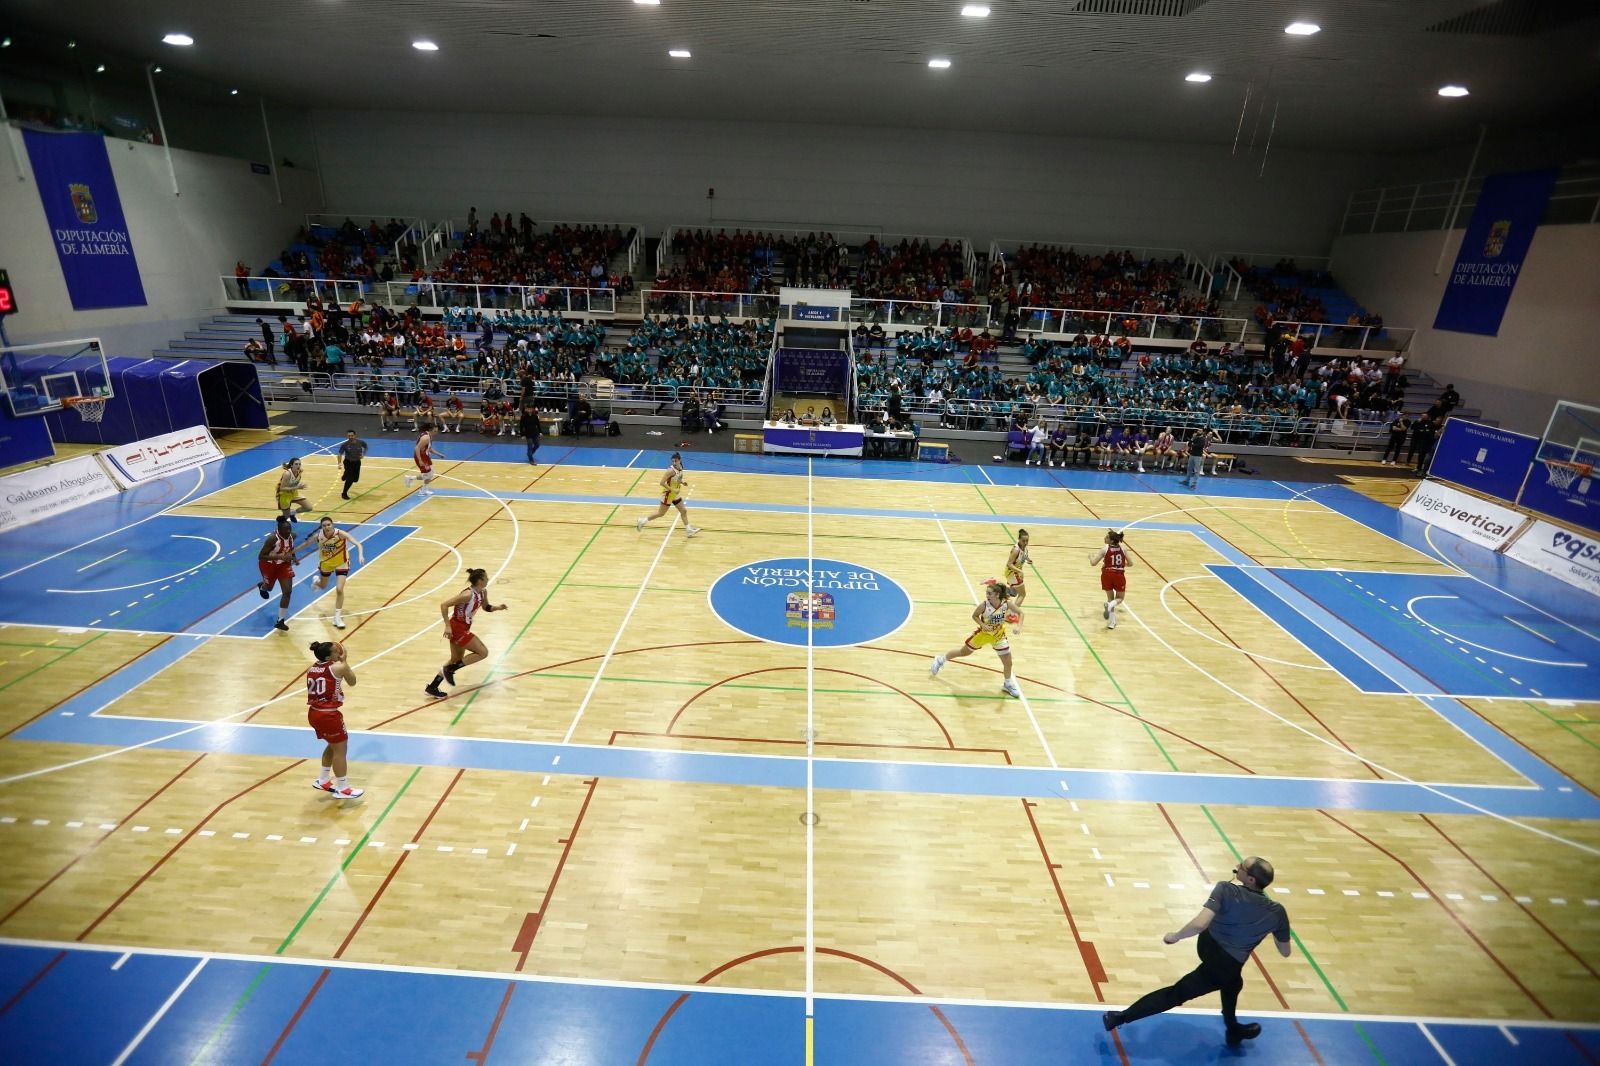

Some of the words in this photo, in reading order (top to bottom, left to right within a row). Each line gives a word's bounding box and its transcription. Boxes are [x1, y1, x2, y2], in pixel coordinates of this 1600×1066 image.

[56, 229, 128, 243] DIPUTACIÓN
[61, 243, 78, 255] DE
[81, 243, 129, 255] ALMERÍA
[1456, 262, 1519, 275] DIPUTACIÓN
[1454, 274, 1465, 285] DE
[1467, 274, 1511, 287] ALMERÍA
[6, 484, 58, 504] Galdeano
[60, 471, 103, 489] Abogados
[1415, 494, 1513, 537] viajesvertical
[1110, 554, 1122, 566] 18
[748, 567, 841, 579] ALMERÍA
[848, 571, 876, 581] DE
[743, 576, 880, 590] DIPUTACIÓN
[308, 677, 326, 695] 20
